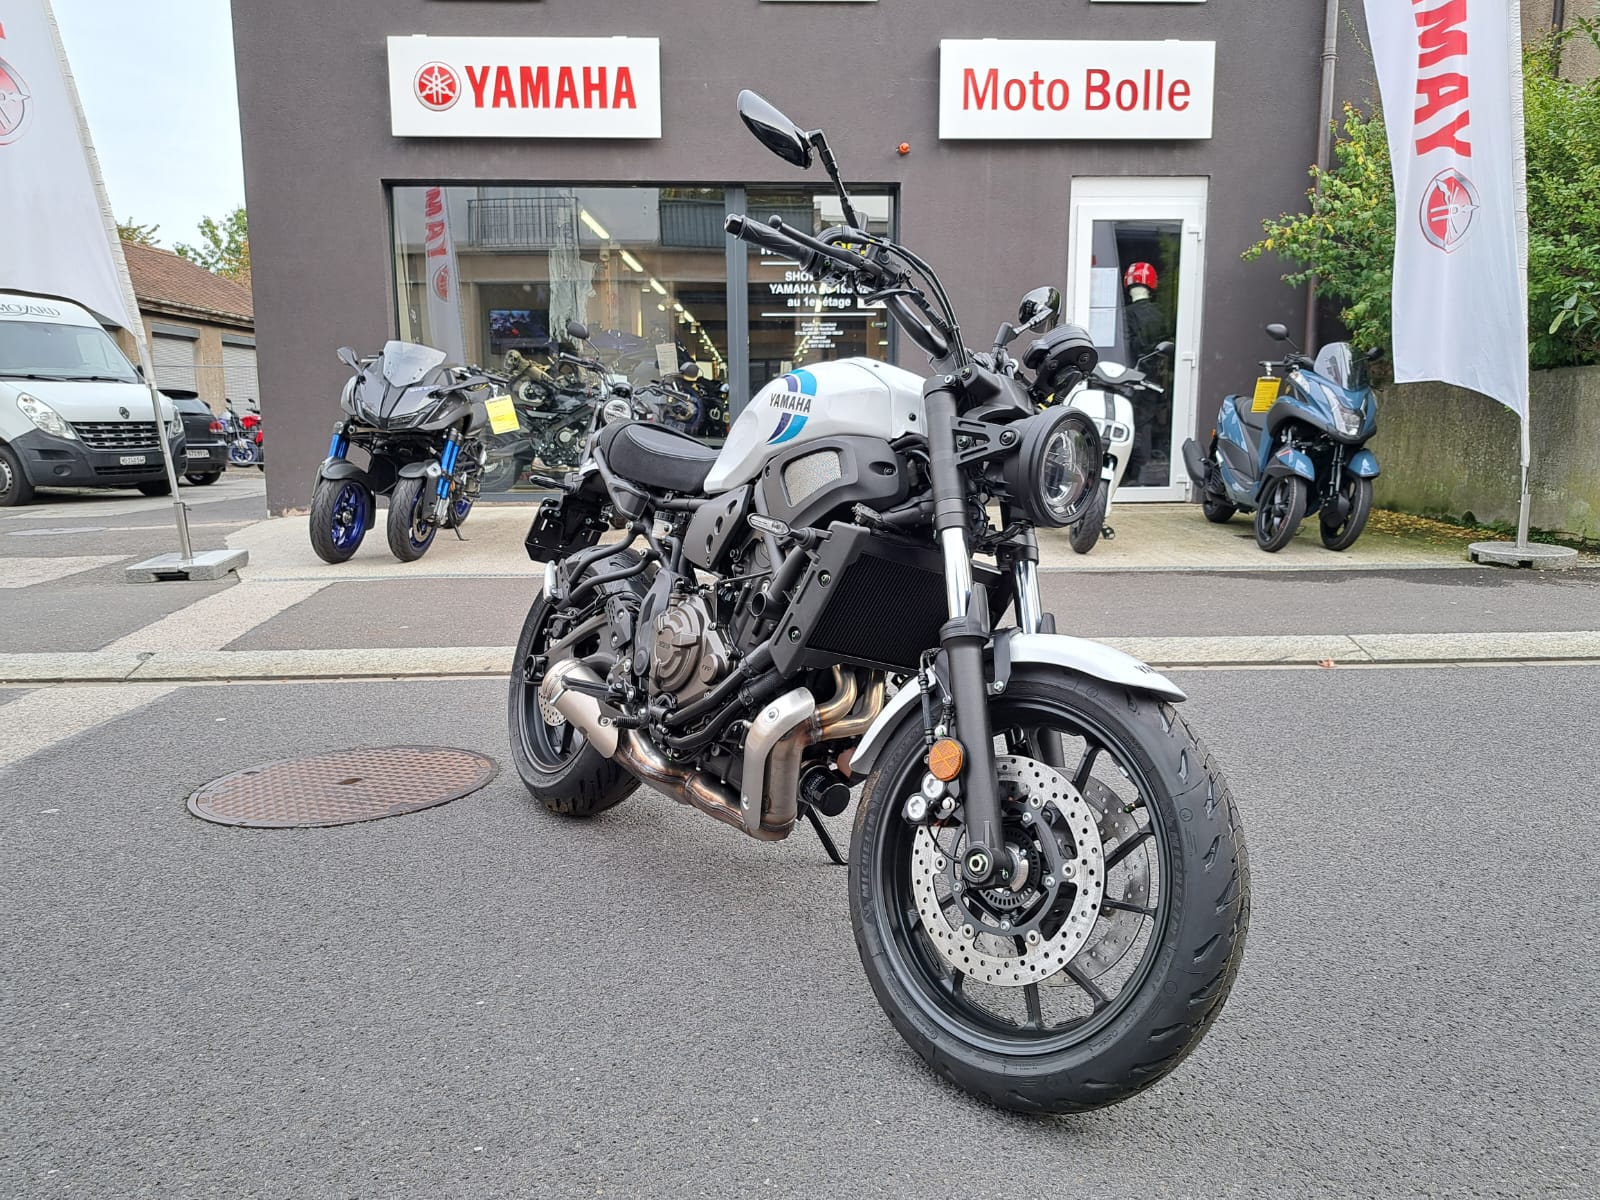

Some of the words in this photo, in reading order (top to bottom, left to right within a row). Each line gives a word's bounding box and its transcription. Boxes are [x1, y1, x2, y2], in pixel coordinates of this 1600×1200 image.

[464, 65, 637, 109] YAMAHA
[962, 67, 1070, 111] Moto
[1085, 68, 1191, 111] Bolle
[785, 271, 814, 282] SHO
[769, 284, 817, 295] YAMAHA
[787, 298, 800, 307] au
[822, 297, 852, 309] étage
[769, 393, 812, 413] YAMAHA
